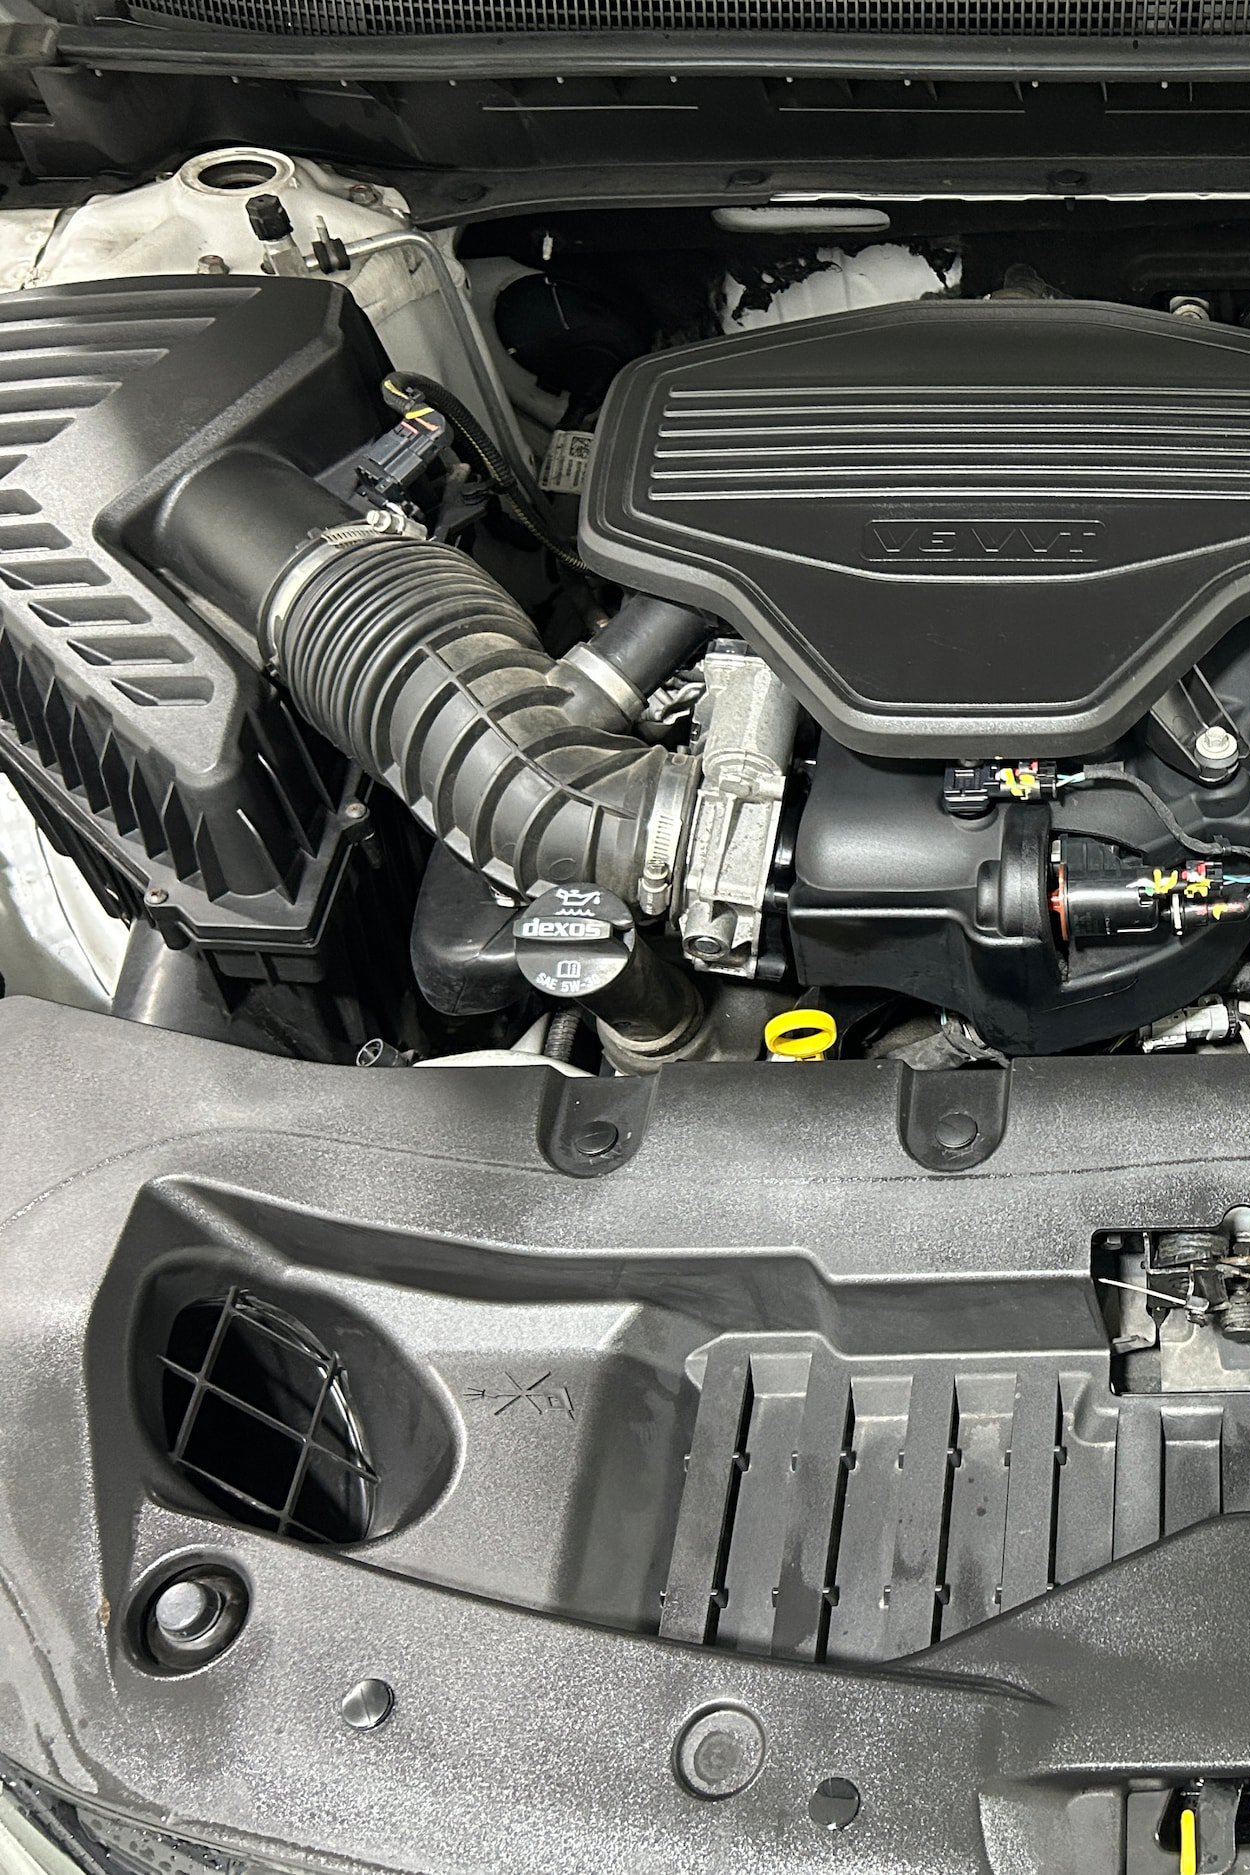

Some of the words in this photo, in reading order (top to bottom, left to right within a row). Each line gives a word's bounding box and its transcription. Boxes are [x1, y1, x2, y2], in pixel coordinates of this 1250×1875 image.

[874, 528, 957, 553] V6
[971, 528, 1097, 553] VVT
[522, 918, 601, 936] dexos
[536, 972, 558, 990] SAE
[560, 974, 600, 992] 5W-30
